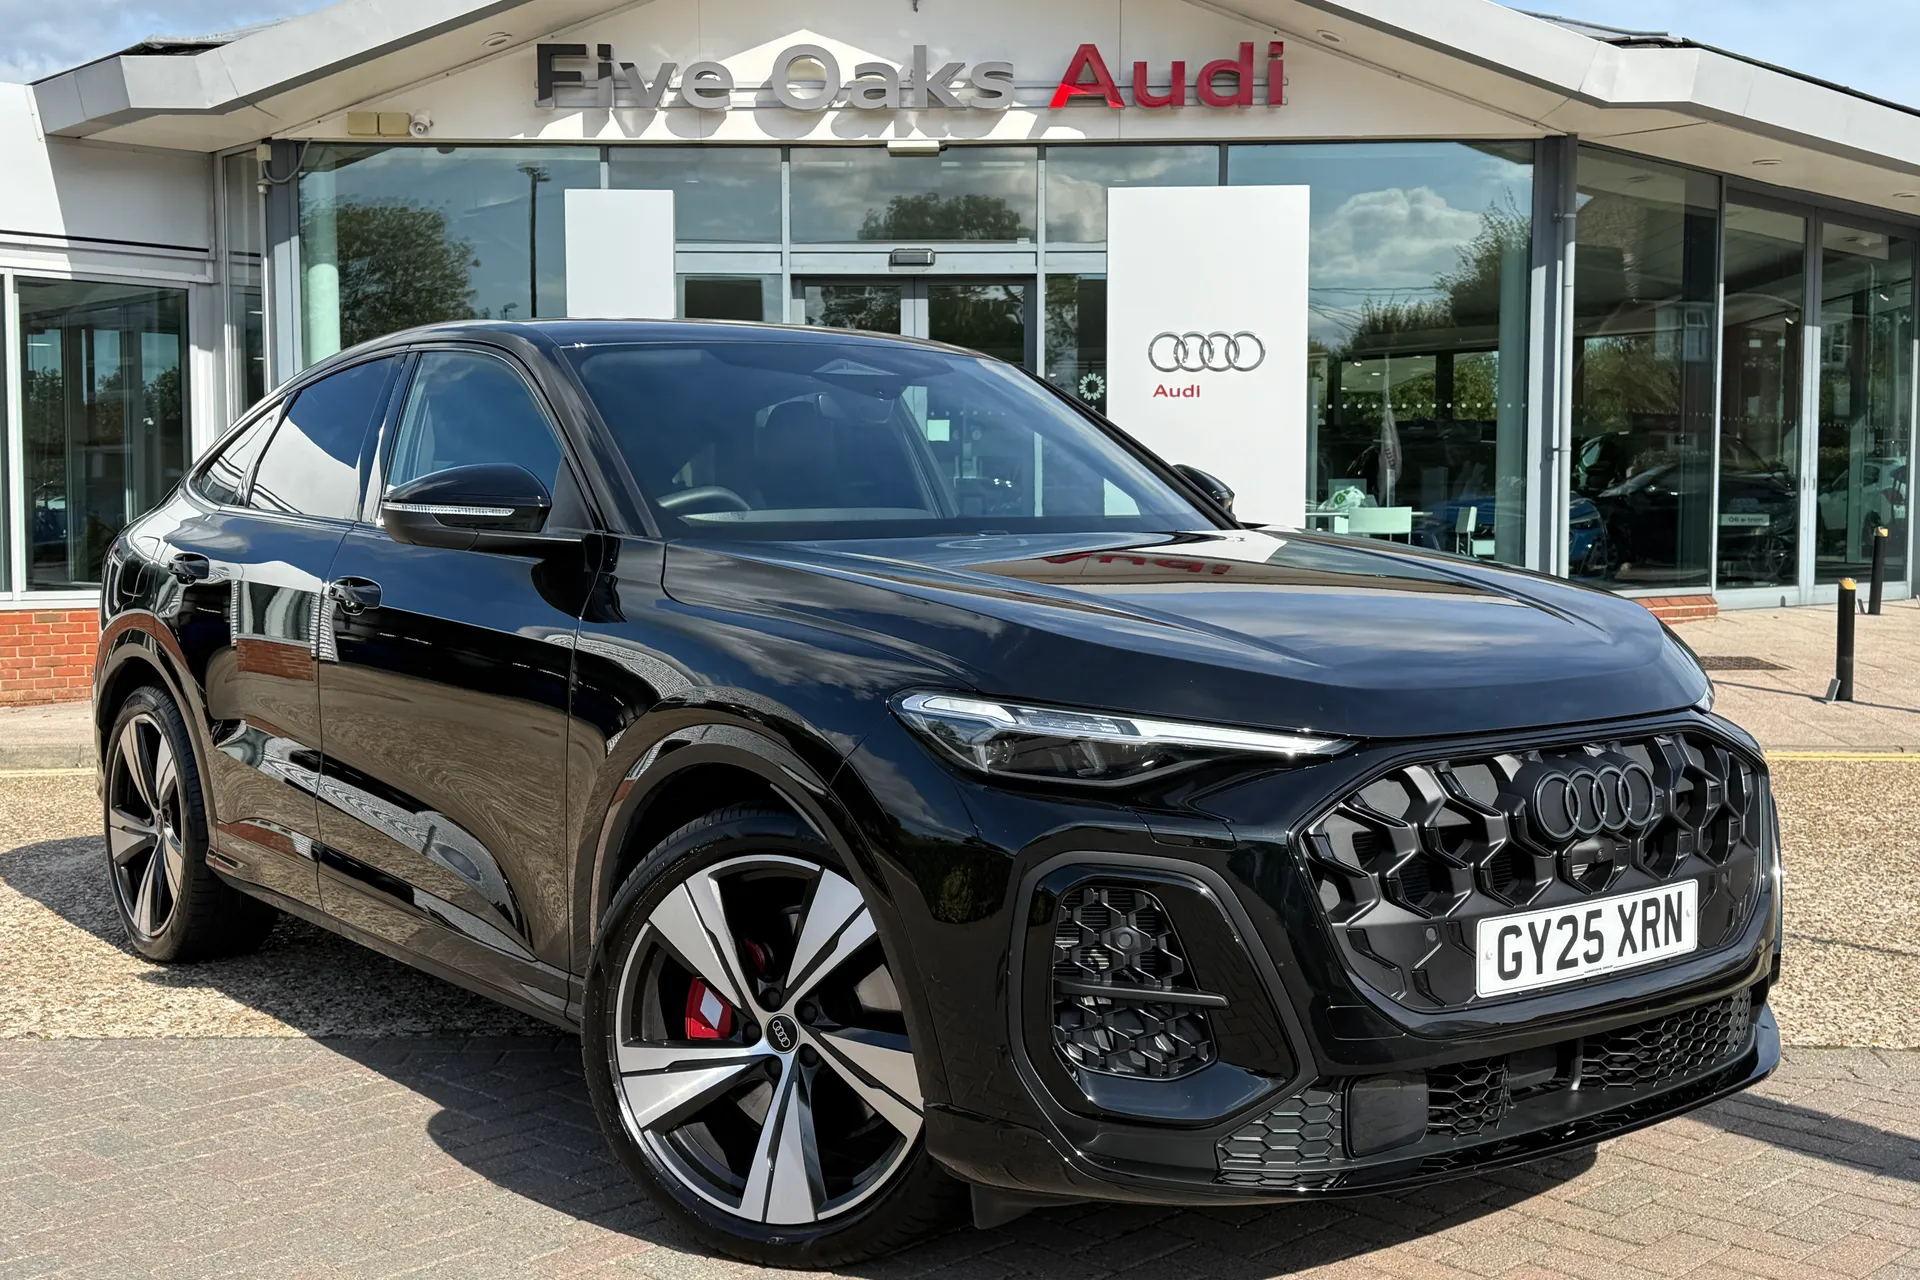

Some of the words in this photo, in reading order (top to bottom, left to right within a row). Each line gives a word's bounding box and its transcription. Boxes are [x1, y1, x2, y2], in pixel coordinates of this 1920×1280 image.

[536, 43, 735, 110] Five
[771, 43, 1016, 111] Oaks
[1048, 41, 1285, 108] Audi
[1152, 383, 1200, 398] Audi
[1497, 908, 1604, 981] GY25
[1617, 891, 1683, 957] XRN
